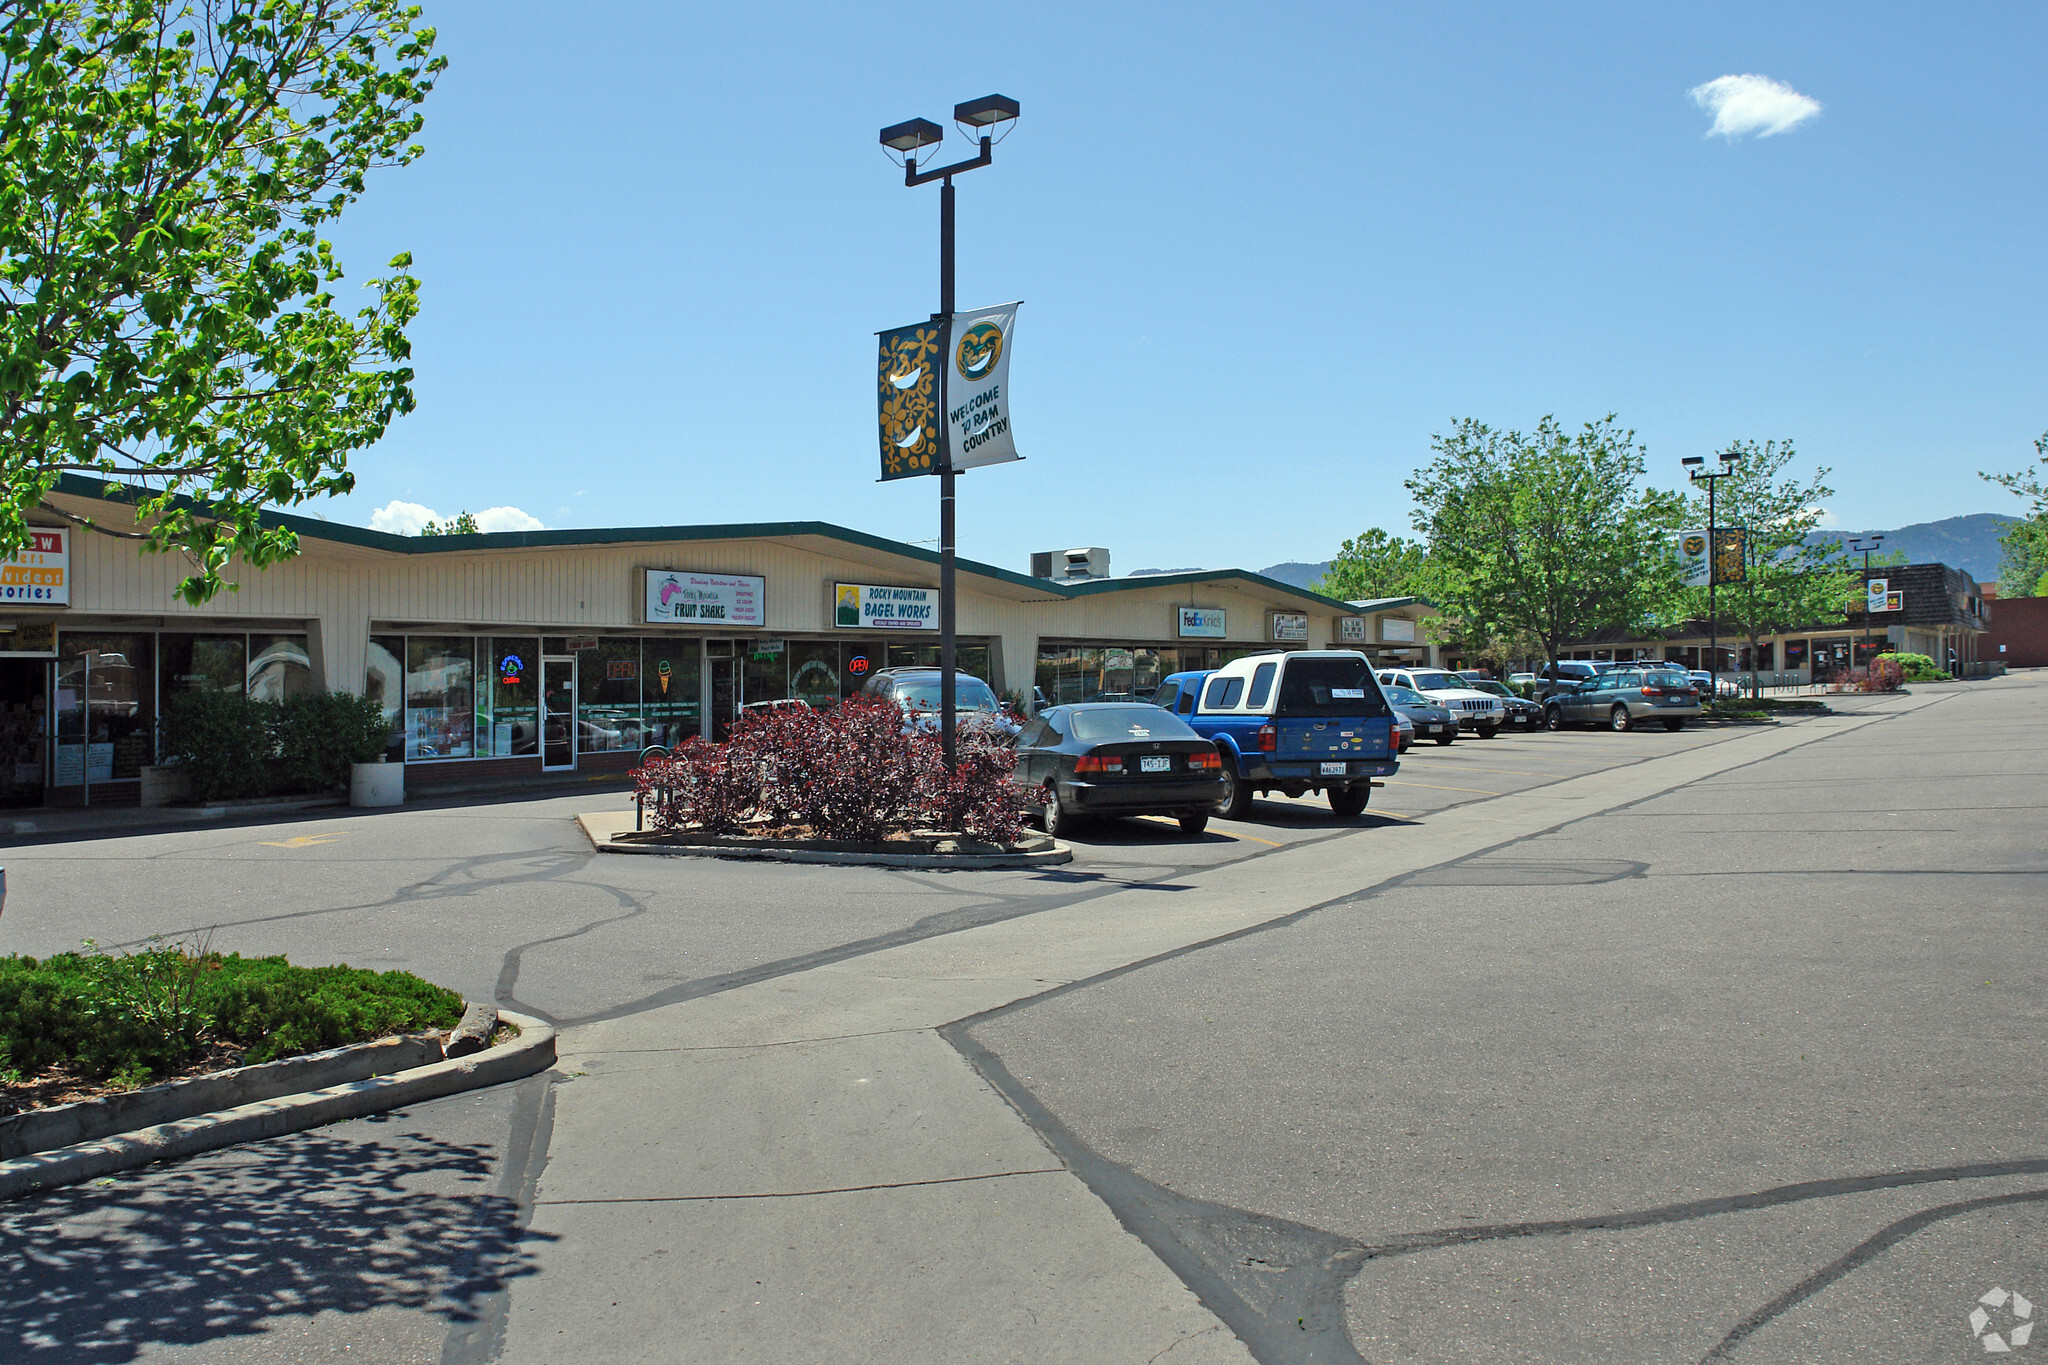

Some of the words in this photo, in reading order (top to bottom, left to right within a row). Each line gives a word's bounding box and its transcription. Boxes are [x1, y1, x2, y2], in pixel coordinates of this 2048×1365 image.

[950, 385, 1000, 424] WELCOME
[961, 418, 971, 435] TO
[973, 404, 999, 427] RAM
[963, 417, 1008, 453] COUNTRY
[5, 570, 61, 584] videos
[869, 587, 892, 600] ROCKY
[892, 589, 927, 602] MOUNTAIN
[674, 603, 698, 618] FRUIT
[700, 604, 726, 619] SHAKE
[864, 602, 895, 617] BAGEL
[898, 604, 931, 619] WORKS
[1184, 612, 1203, 627] FedEx
[1203, 614, 1221, 628] Kinko's
[500, 655, 524, 671] ESPRESSO
[607, 661, 636, 679] OPEN
[849, 659, 869, 672] OPEN
